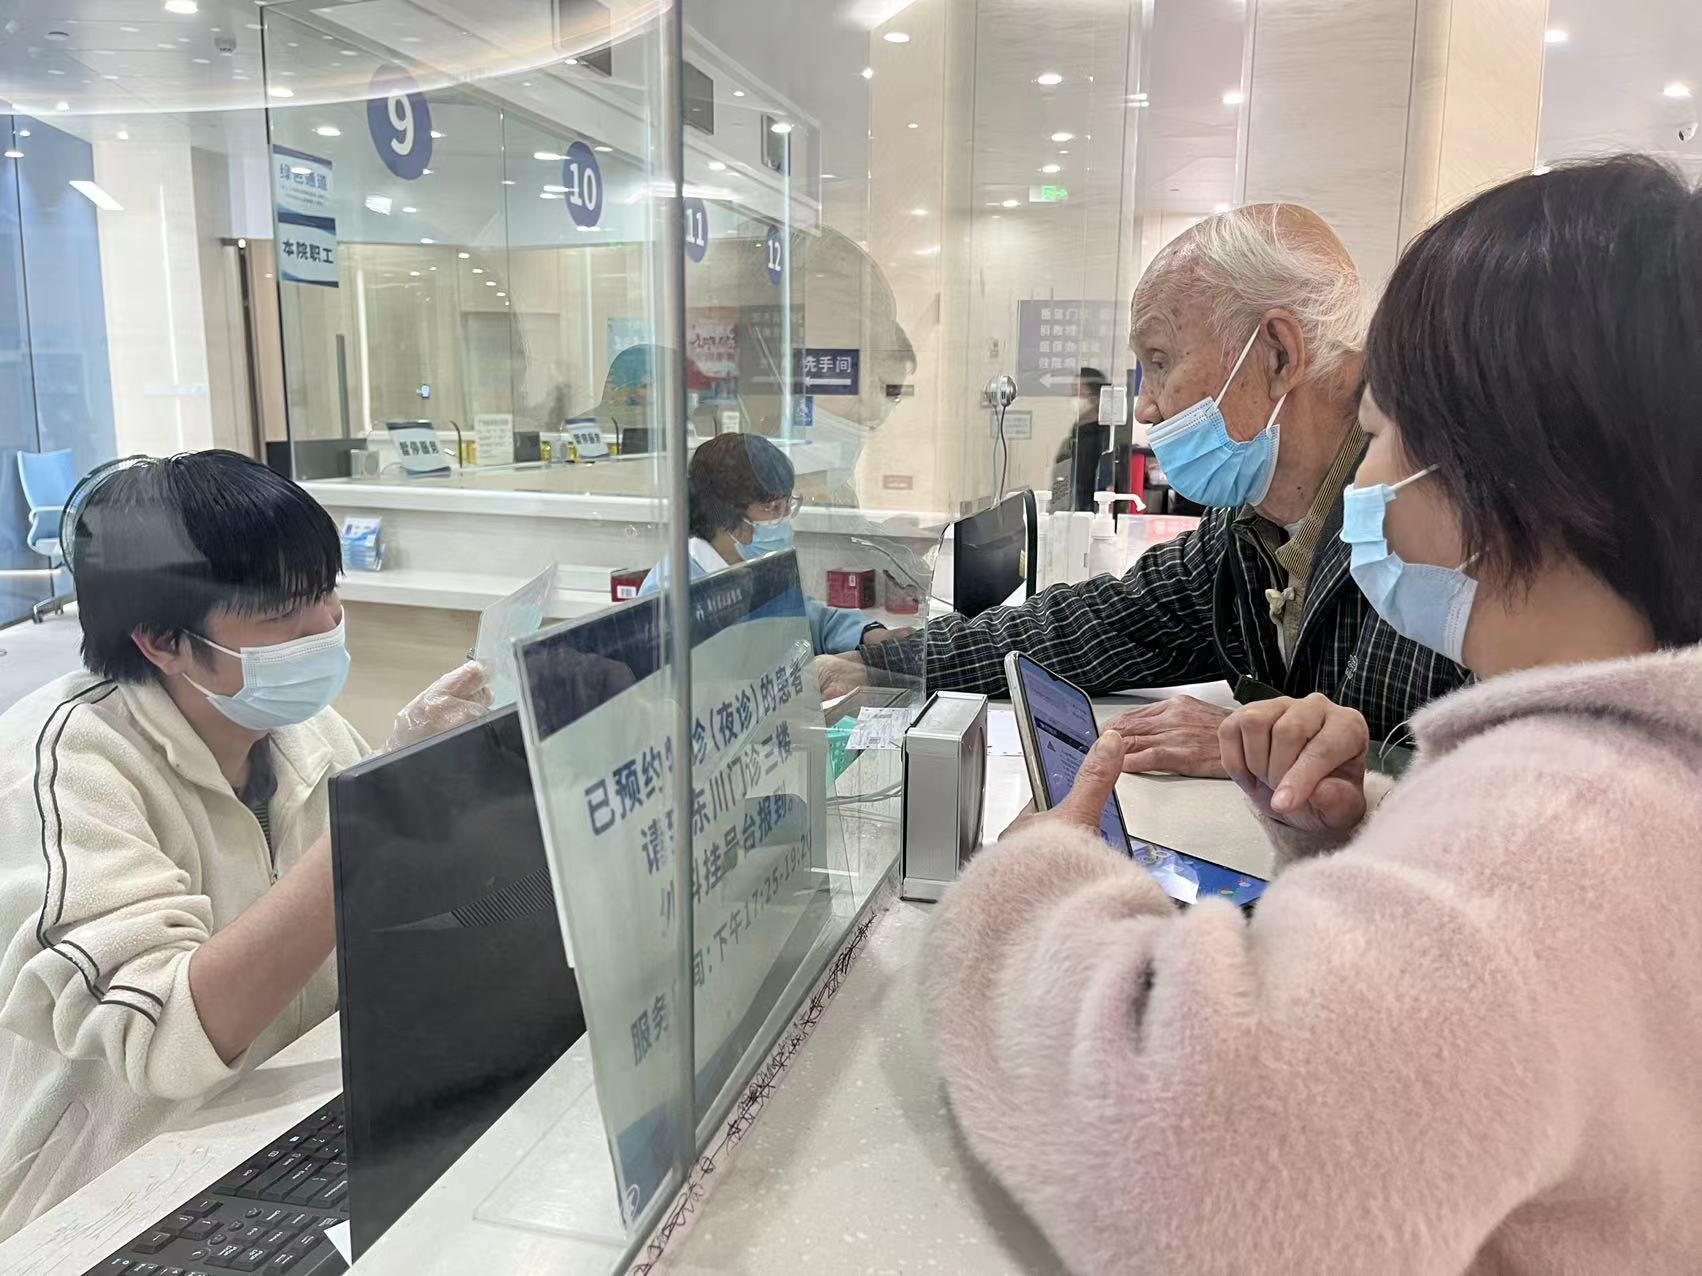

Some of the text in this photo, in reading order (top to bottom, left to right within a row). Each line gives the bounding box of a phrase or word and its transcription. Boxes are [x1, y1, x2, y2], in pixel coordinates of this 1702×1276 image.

[387, 88, 415, 156] 9
[569, 163, 597, 211] 10
[685, 208, 705, 247] 11
[282, 239, 334, 264] 本院职工
[767, 239, 782, 272] 12
